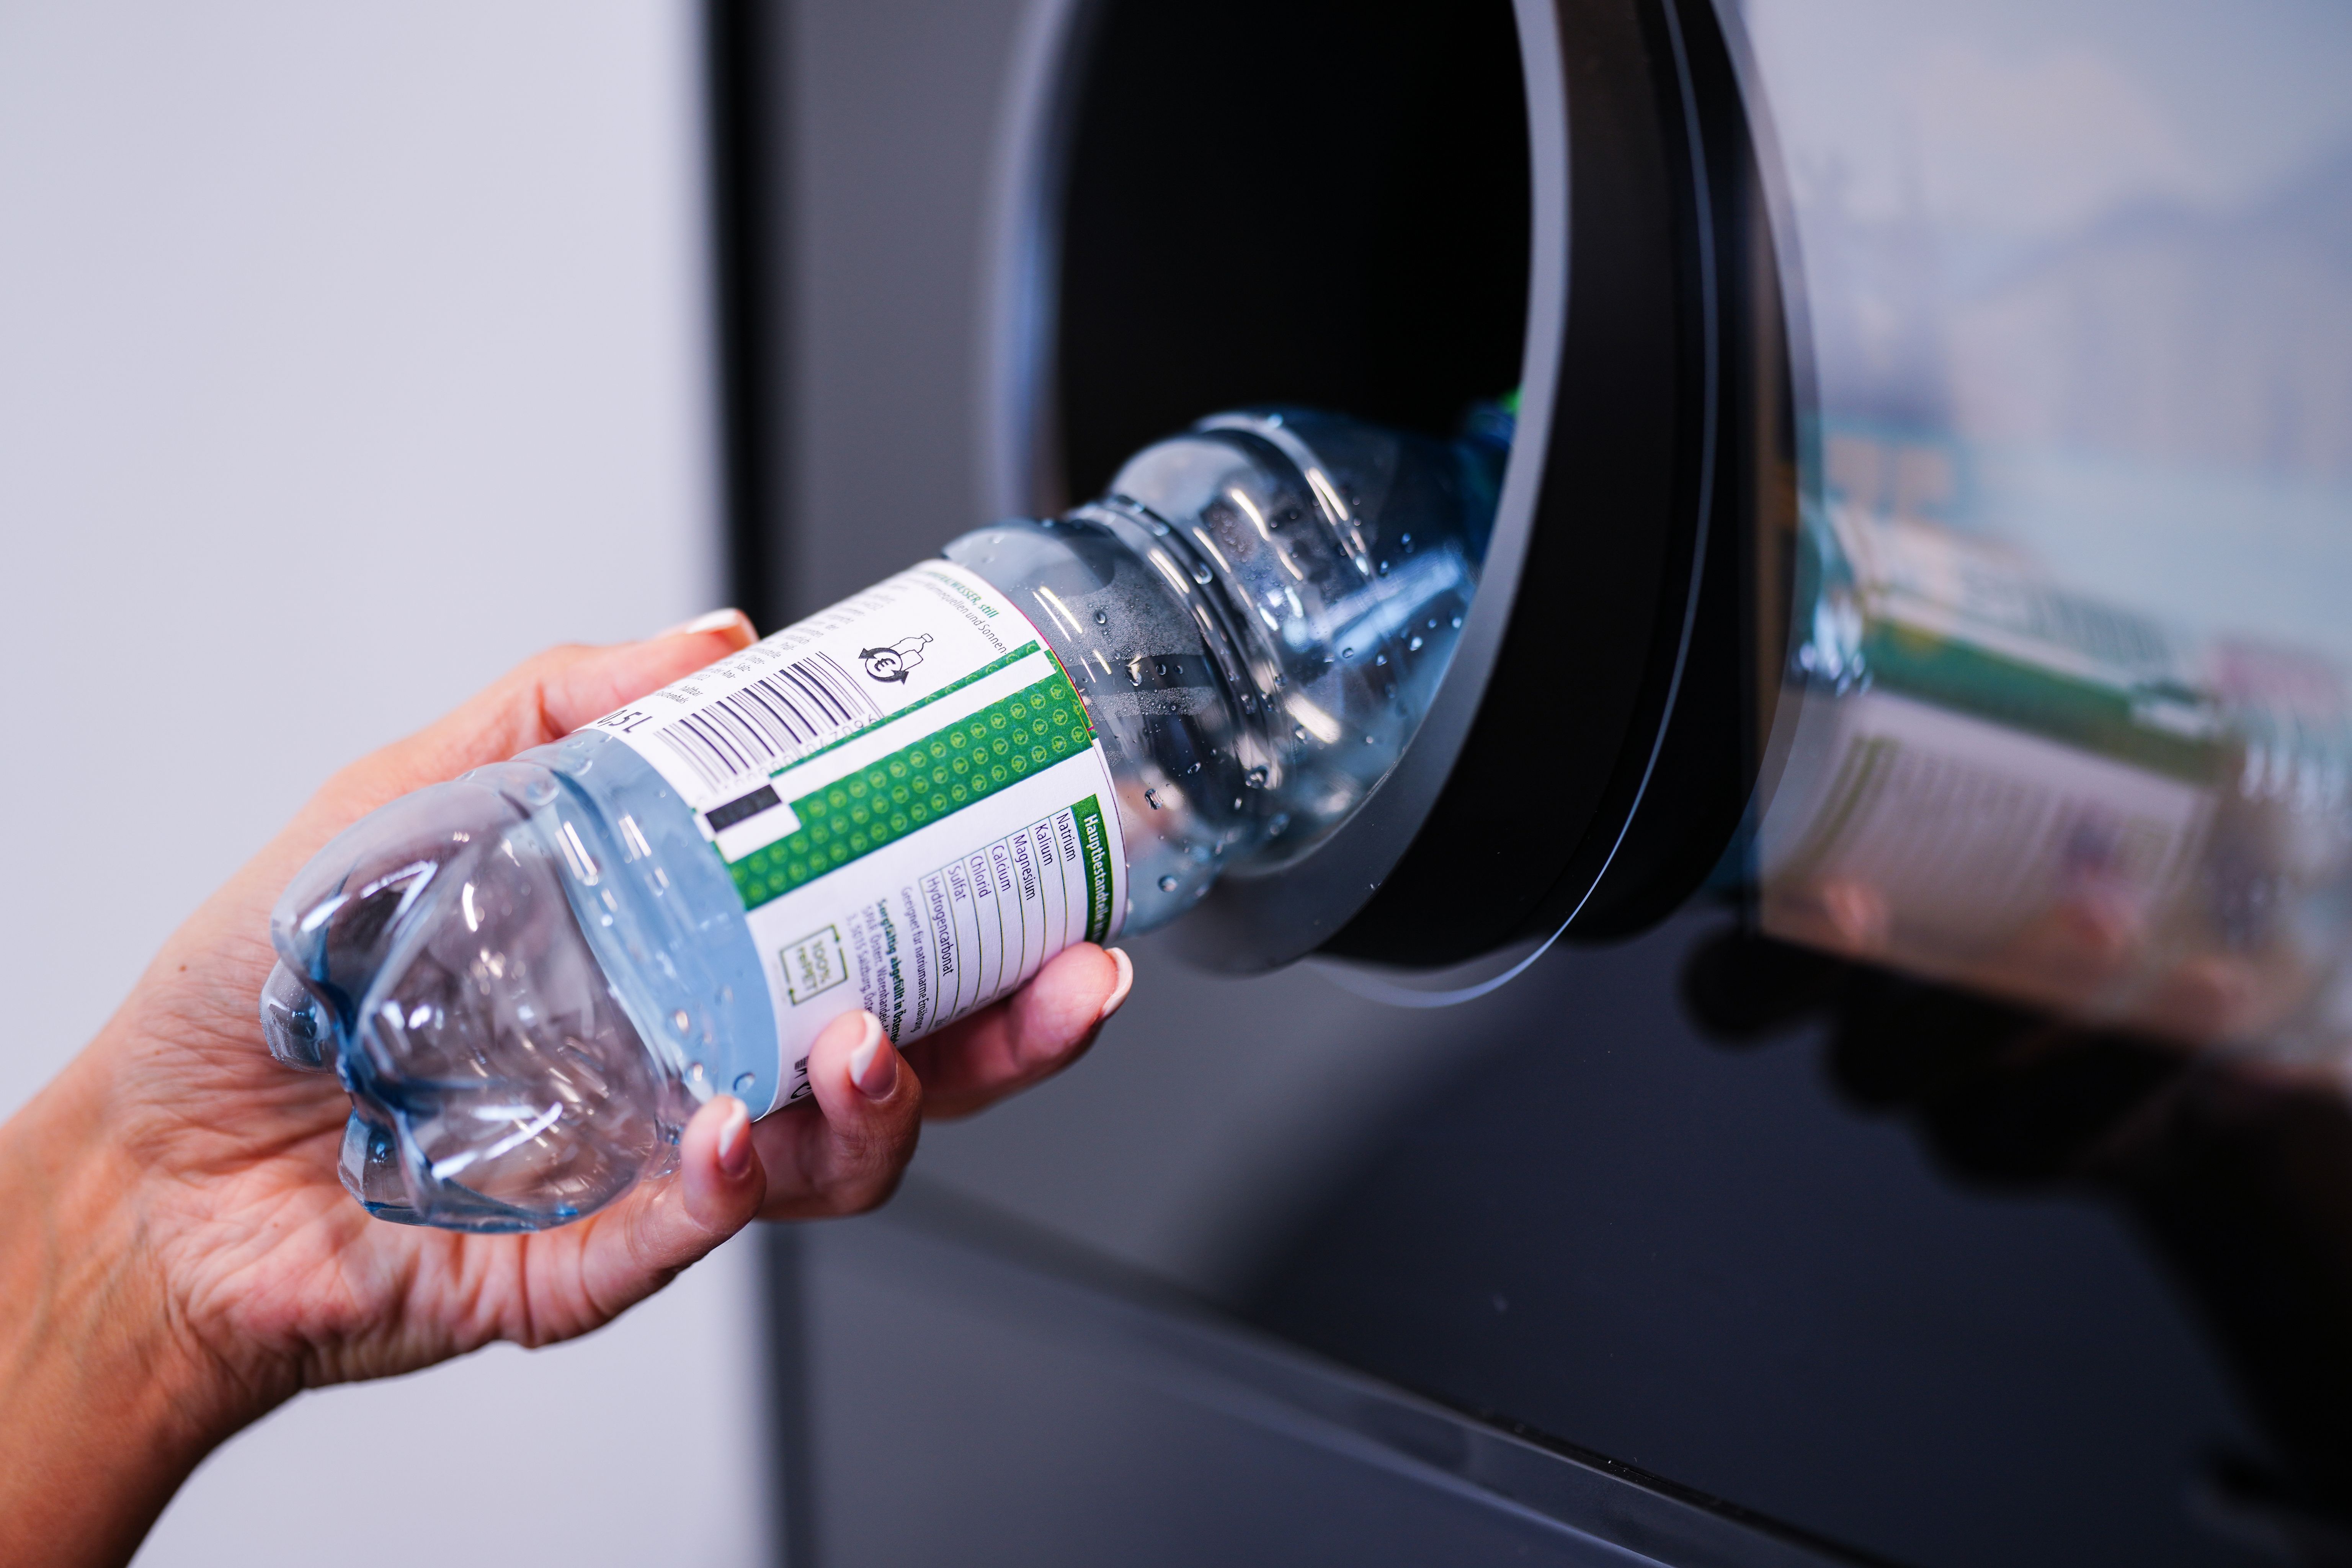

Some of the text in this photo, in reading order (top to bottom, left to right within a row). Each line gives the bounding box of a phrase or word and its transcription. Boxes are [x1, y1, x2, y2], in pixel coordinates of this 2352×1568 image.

[978, 604, 999, 618] still
[965, 612, 985, 626] und
[978, 624, 1007, 654] Sonnen-
[720, 670, 736, 678] Ana-
[734, 663, 750, 671] Salz-
[745, 655, 765, 664] Unter-
[679, 685, 704, 697] haltbar
[1035, 823, 1053, 866] Kalium
[1057, 813, 1076, 862] Natrium
[947, 866, 968, 903] Sulfat
[970, 856, 992, 898] Chlorid
[992, 845, 1011, 892] Calcium
[1014, 834, 1036, 901] Magnesium
[877, 898, 898, 955] Sorgfältig
[925, 875, 954, 977] Hydrogencarbonat
[889, 955, 905, 1002] abgefüllt
[901, 886, 929, 1033] Geeignet für natriumarme Ernährung
[894, 1000, 905, 1012] in
